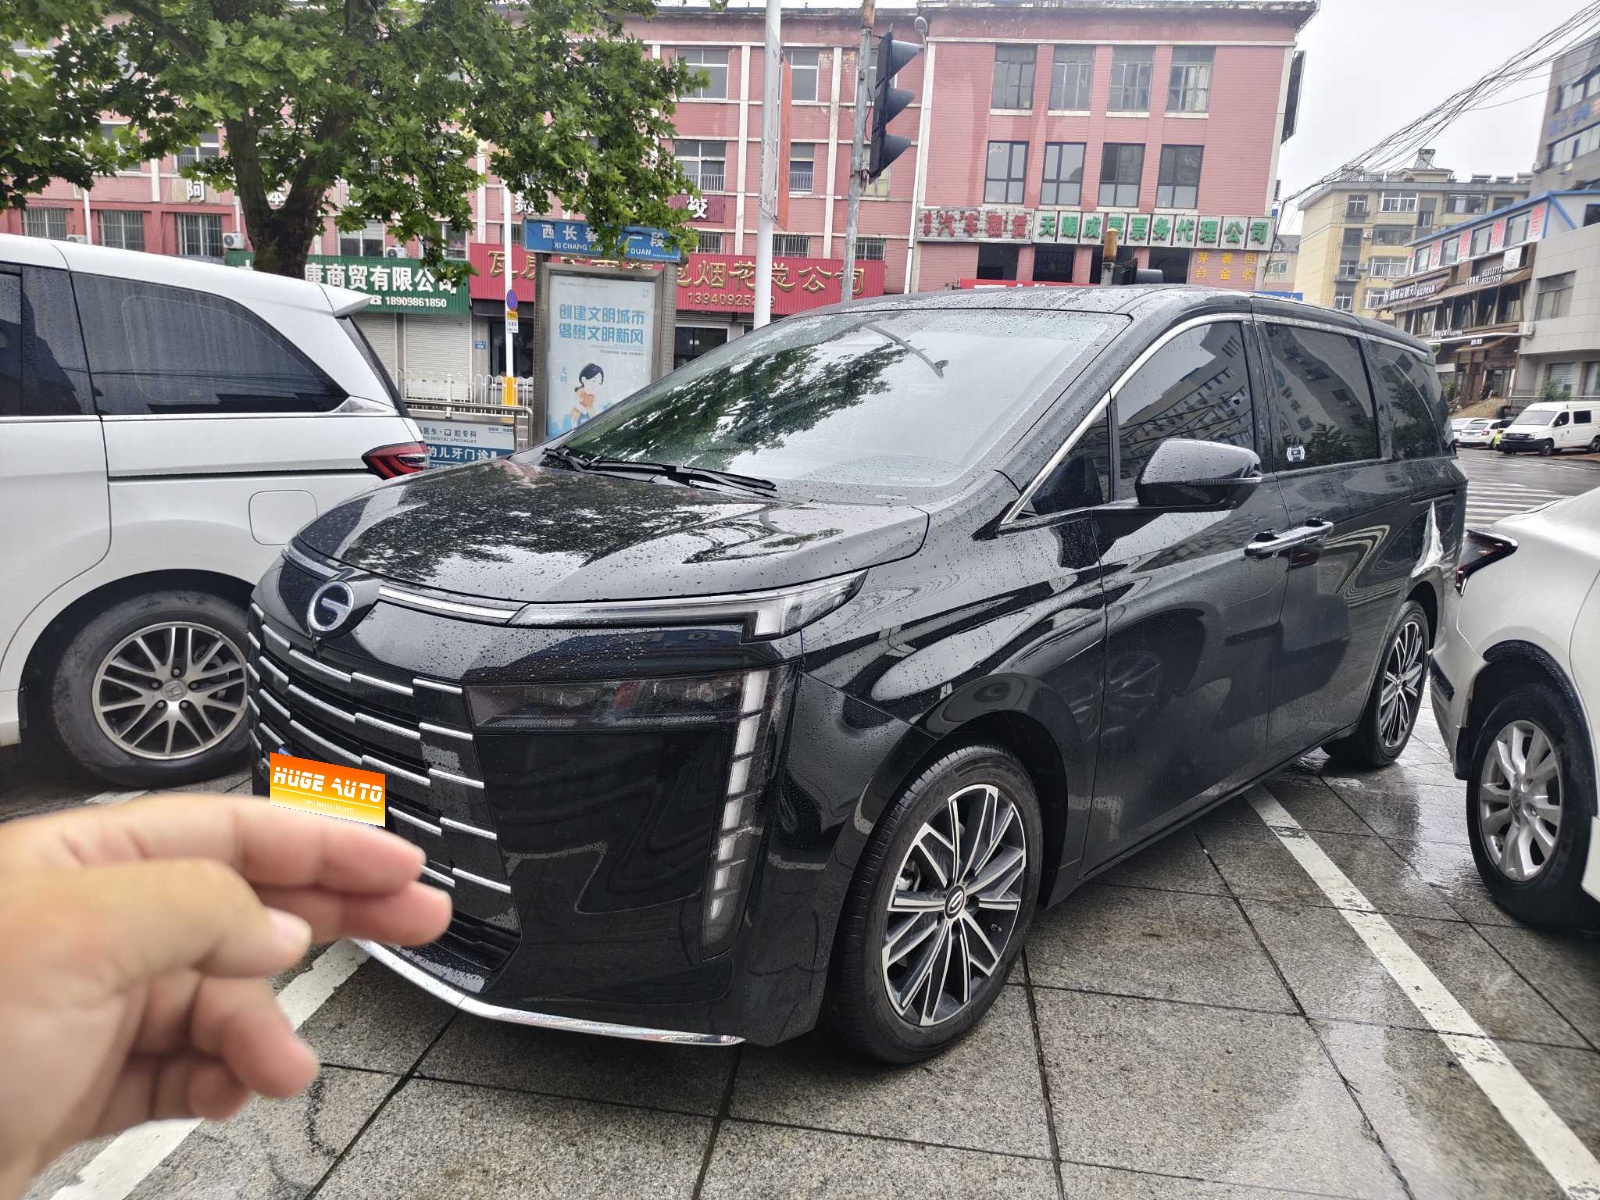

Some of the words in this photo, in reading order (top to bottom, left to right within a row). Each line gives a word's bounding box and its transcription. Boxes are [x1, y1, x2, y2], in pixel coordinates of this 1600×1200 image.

[187, 180, 205, 201] 阿
[541, 224, 665, 248] 西长春一段
[562, 242, 587, 251] CHANG
[630, 248, 651, 256] DUAN
[385, 295, 447, 308] 18909861850
[687, 291, 776, 307] 139409259
[559, 303, 645, 325] 创建文明城市
[558, 323, 644, 345] 倡树文明新风
